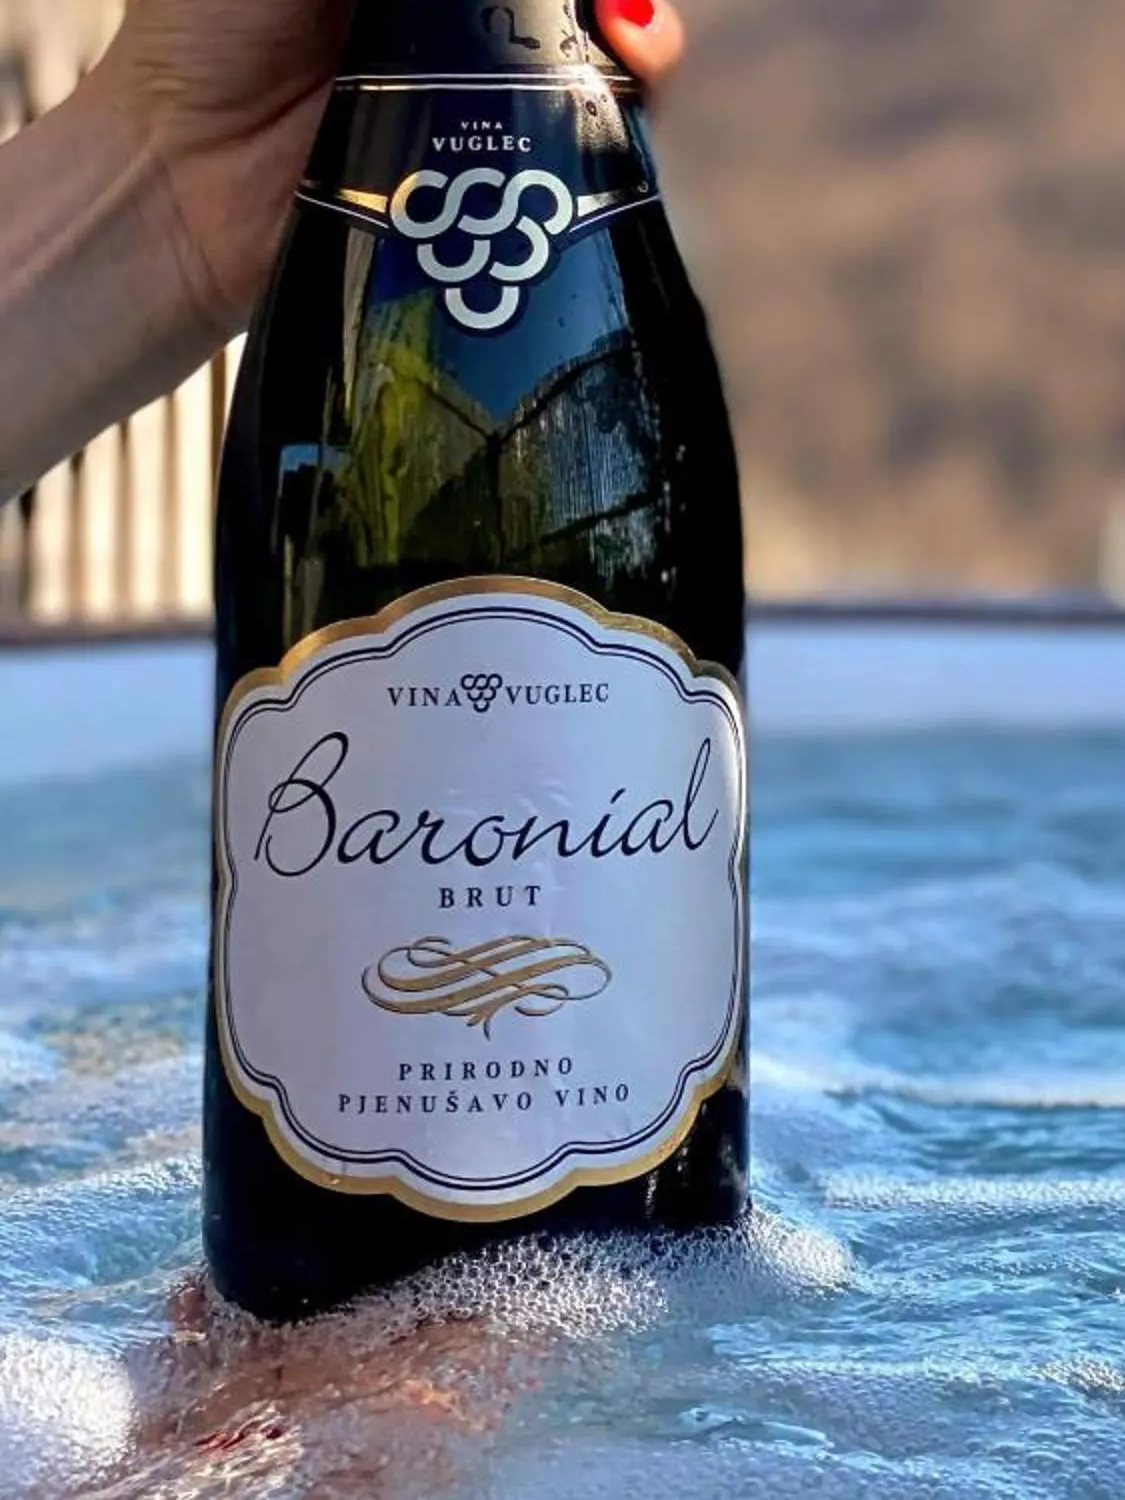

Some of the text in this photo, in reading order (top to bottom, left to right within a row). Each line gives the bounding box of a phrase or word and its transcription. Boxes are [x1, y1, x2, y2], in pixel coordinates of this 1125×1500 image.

[460, 120, 503, 130] VINA
[431, 136, 532, 152] VUGLEC
[387, 682, 610, 708] VINA VUGLEC
[253, 731, 720, 877] Baronial
[438, 885, 542, 909] BRUT
[398, 1056, 574, 1082] PRIRODNO
[338, 1083, 630, 1114] PJENUŠAVO VINO
